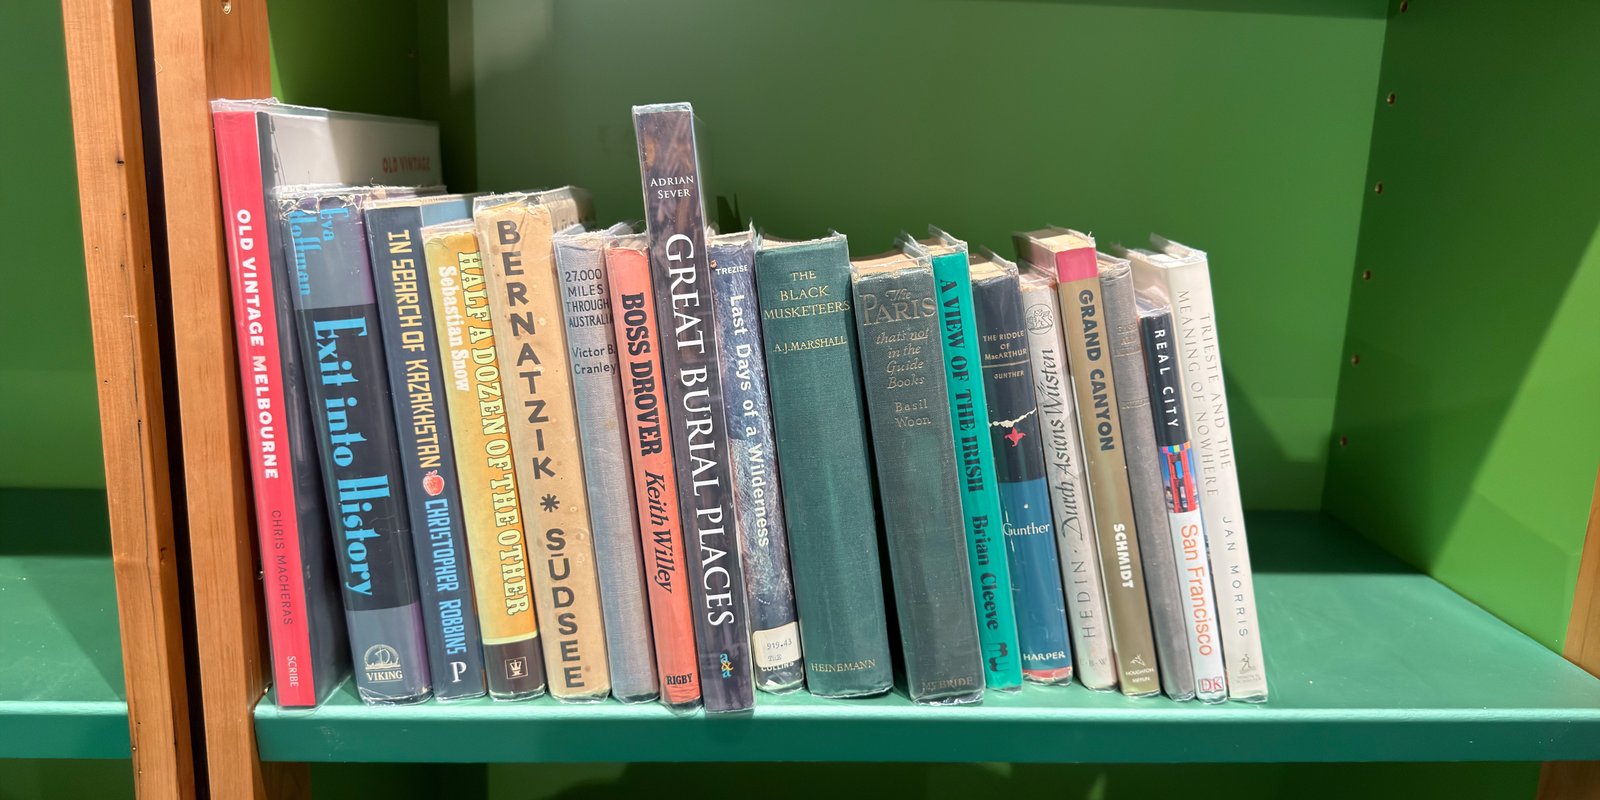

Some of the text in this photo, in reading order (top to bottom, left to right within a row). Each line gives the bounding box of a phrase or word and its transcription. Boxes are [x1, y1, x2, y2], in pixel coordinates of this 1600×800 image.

[650, 175, 694, 187] ADRIAN
[657, 188, 691, 199] SEVER
[320, 208, 349, 241] Eva
[715, 265, 748, 275] TREZISE
[791, 270, 817, 282] THE
[566, 299, 610, 312] THROUGH
[568, 284, 604, 297] MILES
[780, 285, 830, 301] BLACK
[885, 289, 911, 301] The
[764, 301, 851, 320] MUSKETEERS
[859, 294, 936, 326] PARIS
[438, 265, 470, 391] Sebastian Snow
[910, 329, 931, 341] not
[983, 331, 1025, 342] THE RIDDLE
[237, 209, 278, 479] OLD VINTAGE MELBOURNE
[387, 230, 441, 468] IN SEARCH OF KAZAKHSTAN
[497, 220, 556, 479] BERNATZIK
[572, 347, 605, 358] Victor
[887, 344, 921, 358] in the
[984, 348, 1027, 361] MacARTHUR
[574, 362, 617, 375] Cranley
[621, 292, 662, 456] BOSS DROVER
[886, 358, 924, 373] Guide
[887, 373, 926, 389] Books
[1079, 289, 1115, 451] GRAND CANYON
[1154, 328, 1179, 427] REAL CITY
[940, 279, 984, 492] A VIEW OF THE IRISH
[1037, 348, 1064, 416] Wüsten
[1177, 290, 1219, 497] MEANING OF NOWHERE
[1200, 313, 1231, 469] TRIESTE AND THE
[895, 399, 928, 412] Basil
[457, 252, 530, 616] HALF A DOZEN OF THE OTHER
[665, 234, 735, 626] GREAT BURIAL PLACES
[730, 295, 769, 548] Last Days of a Wilderness
[894, 416, 931, 427] Woon
[313, 317, 391, 595] Exit into History
[1049, 419, 1075, 479] Asiens
[1055, 481, 1084, 541] Durch
[645, 469, 675, 593] Keith Willey
[1002, 522, 1050, 536] Gunther
[271, 510, 293, 625] CHRIS MACHERAS
[1113, 523, 1134, 589] SCHMIDT
[424, 498, 467, 655] CHRISTOPHER ROBBINS
[972, 514, 999, 631] Brian Cleeve
[1223, 516, 1248, 637] JAN MORRIS
[1071, 560, 1096, 639] HEDIN
[1181, 524, 1213, 656] San Francisco
[811, 659, 876, 673] HEINEMANN
[1023, 650, 1066, 661] HARPER
[287, 656, 299, 687] SCRIBE
[367, 671, 403, 680] VIKING
[450, 661, 467, 682] P
[666, 673, 692, 685] RIGBY
[1201, 678, 1223, 691] DK
